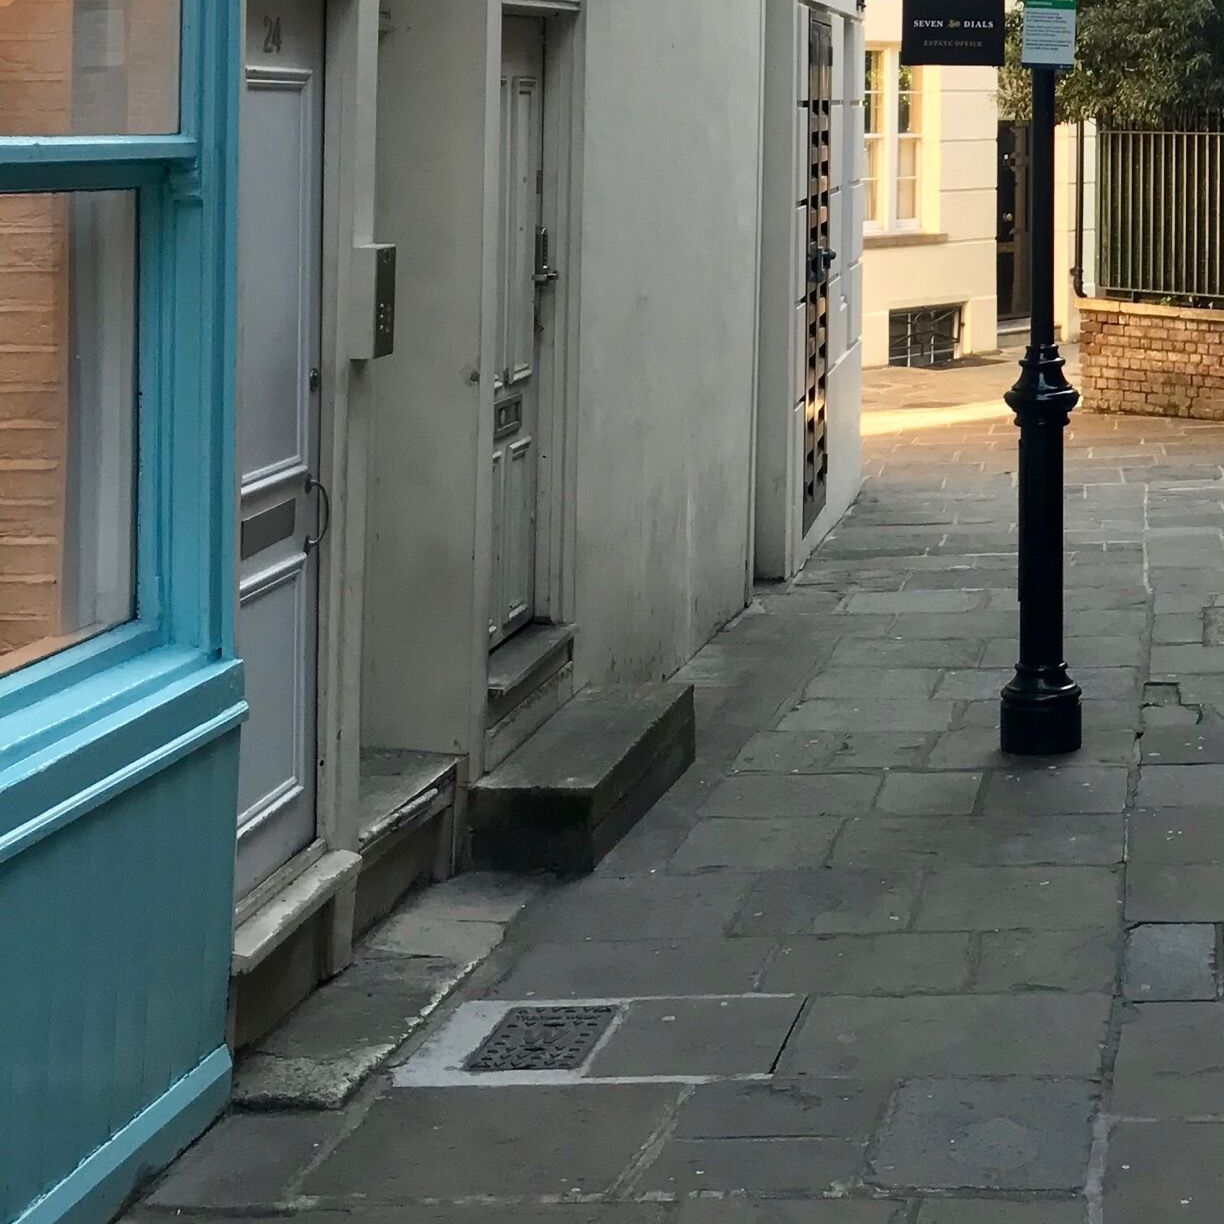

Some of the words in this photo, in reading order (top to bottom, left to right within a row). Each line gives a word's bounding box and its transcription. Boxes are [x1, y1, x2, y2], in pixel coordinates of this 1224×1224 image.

[913, 19, 944, 28] SEVEN
[963, 20, 994, 29] DIALS
[262, 14, 282, 54] 24
[954, 39, 983, 47] OFFICE
